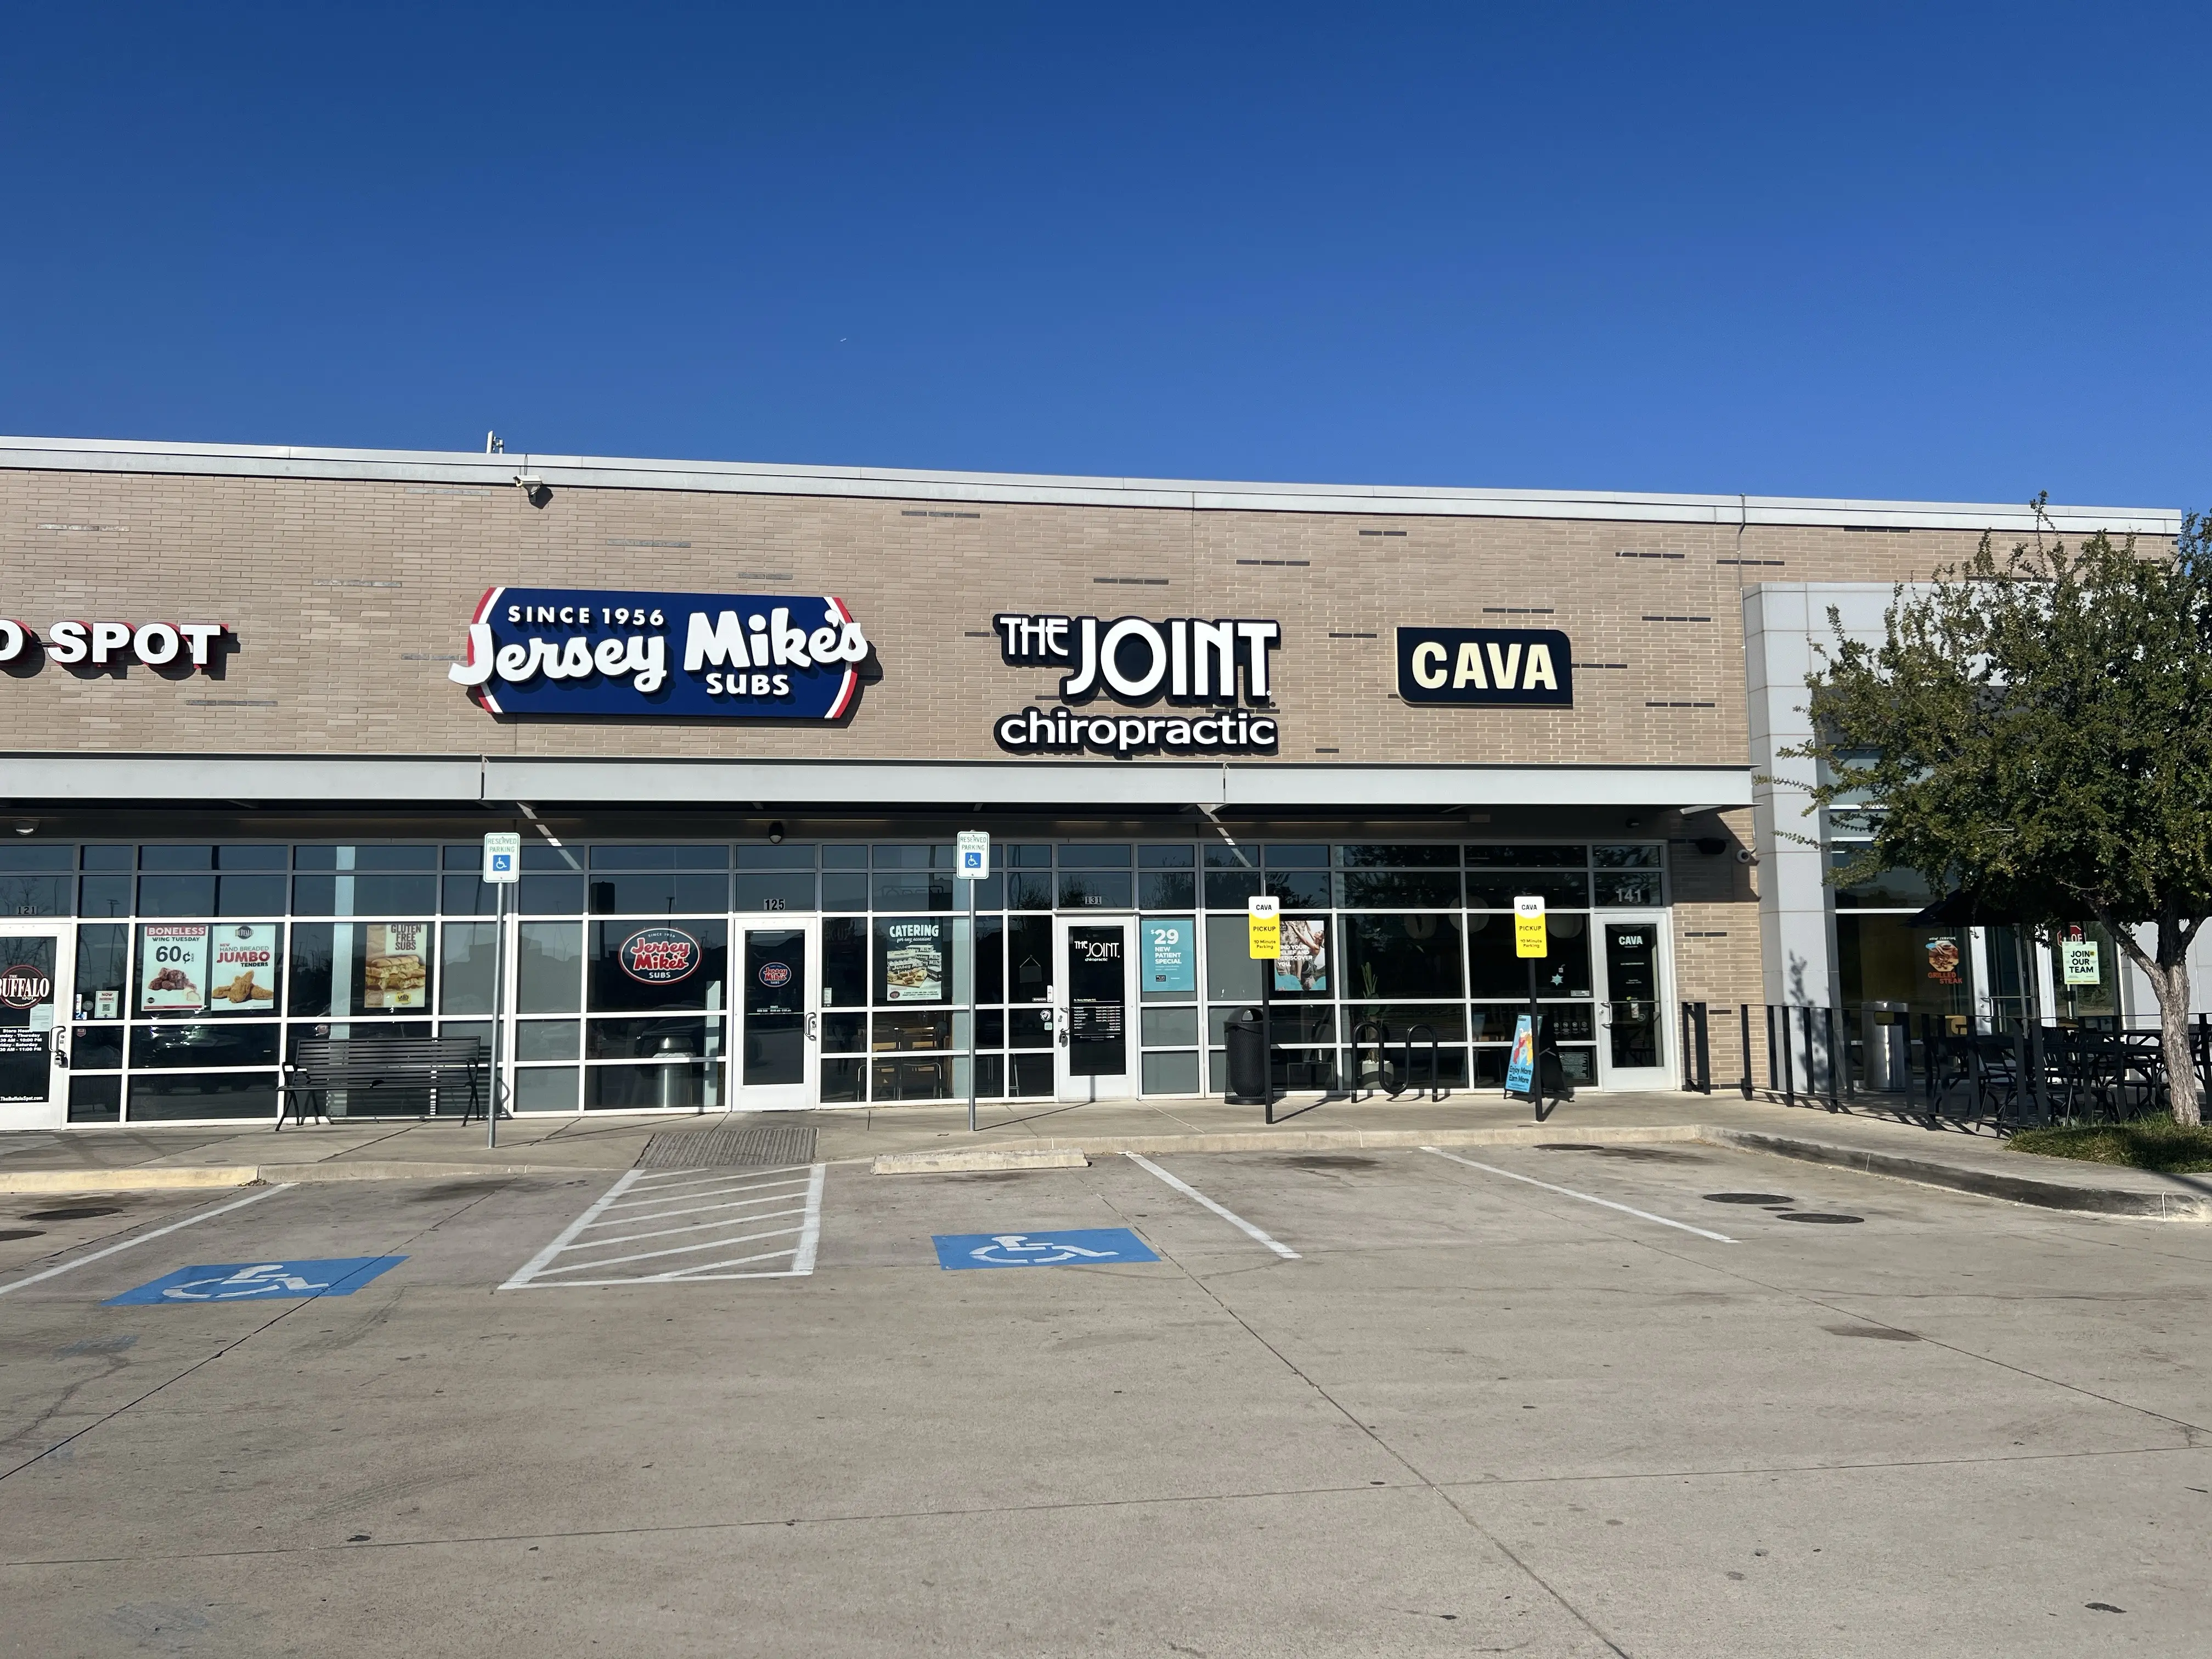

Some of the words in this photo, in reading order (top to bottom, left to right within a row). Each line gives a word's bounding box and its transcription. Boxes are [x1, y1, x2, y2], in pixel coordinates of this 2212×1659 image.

[508, 605, 590, 624] SINCE
[602, 608, 664, 625] 1956
[48, 620, 226, 666] SPOT
[1000, 617, 1068, 656] THE
[448, 624, 665, 692] Jersey
[683, 607, 869, 672] Mike's
[1066, 618, 1277, 696] JOINT
[1412, 641, 1558, 690] CAVA
[706, 672, 789, 696] SUBS
[1000, 712, 1275, 751] chiropractic
[1616, 889, 1641, 902] 141
[18, 906, 36, 915] 121
[765, 899, 785, 910] 125
[148, 927, 205, 935] BONELESS
[391, 924, 421, 933] GLUTEN
[889, 924, 939, 938] CATERING
[396, 933, 416, 942] FREE
[1618, 936, 1644, 945] CAVA
[395, 941, 417, 950] SUBS
[630, 937, 691, 958] Jersey
[1074, 940, 1088, 949] THE
[1086, 943, 1120, 957] JOINT
[156, 945, 191, 964] 60¢
[216, 951, 270, 963] JUMBO
[633, 953, 690, 971] Mike's
[763, 967, 788, 976] Jersey
[1509, 1065, 1520, 1075] Enjoy
[1520, 1066, 1532, 1075] More
[1509, 1074, 1518, 1082] Earn
[1518, 1075, 1530, 1084] More
